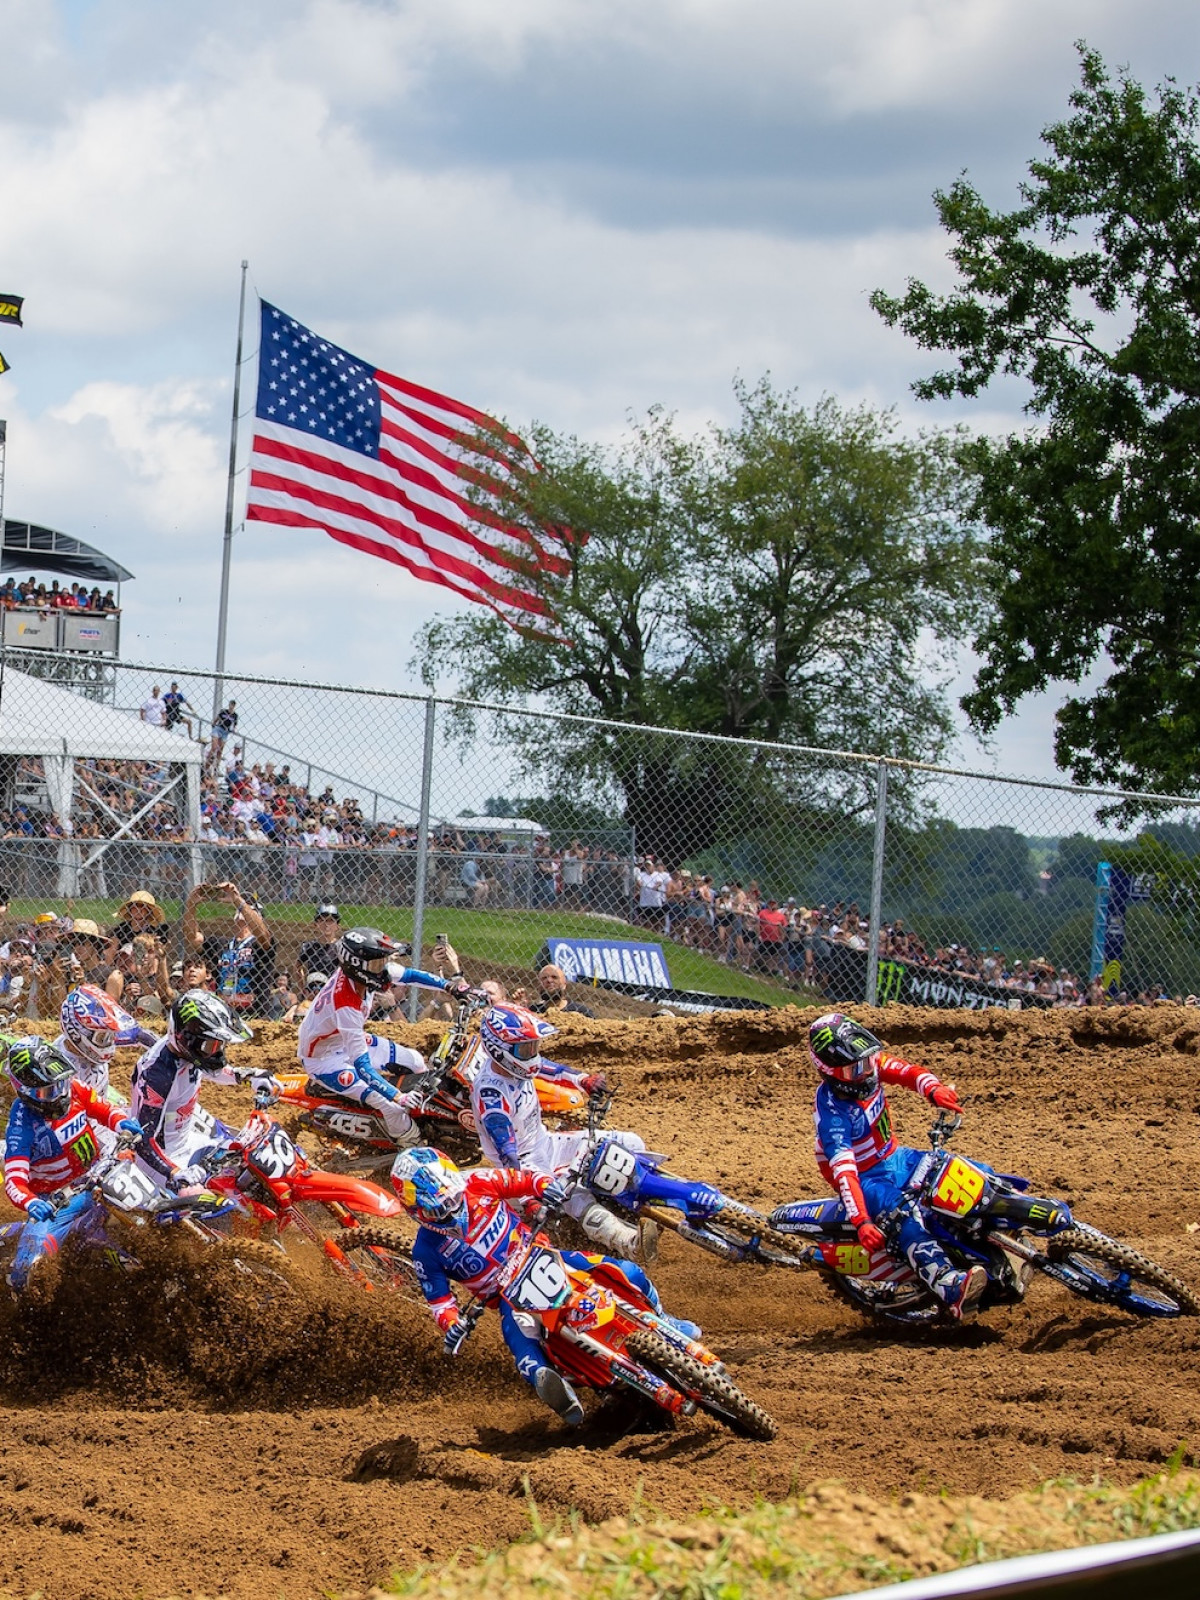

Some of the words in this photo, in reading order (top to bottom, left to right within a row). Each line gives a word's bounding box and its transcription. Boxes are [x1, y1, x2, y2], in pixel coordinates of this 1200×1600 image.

[576, 947, 670, 989] YAMAHA
[328, 1113, 373, 1139] 435
[252, 1130, 296, 1179] 30
[593, 1143, 636, 1196] 99
[4, 1180, 29, 1204] THOR
[838, 1176, 859, 1218] THOR
[937, 1156, 985, 1216] 38
[452, 1252, 486, 1280] 16
[834, 1245, 871, 1275] 38
[1043, 1264, 1090, 1292] DUNLOP
[518, 1253, 567, 1310] 16
[617, 1363, 658, 1392] DUNLOP
